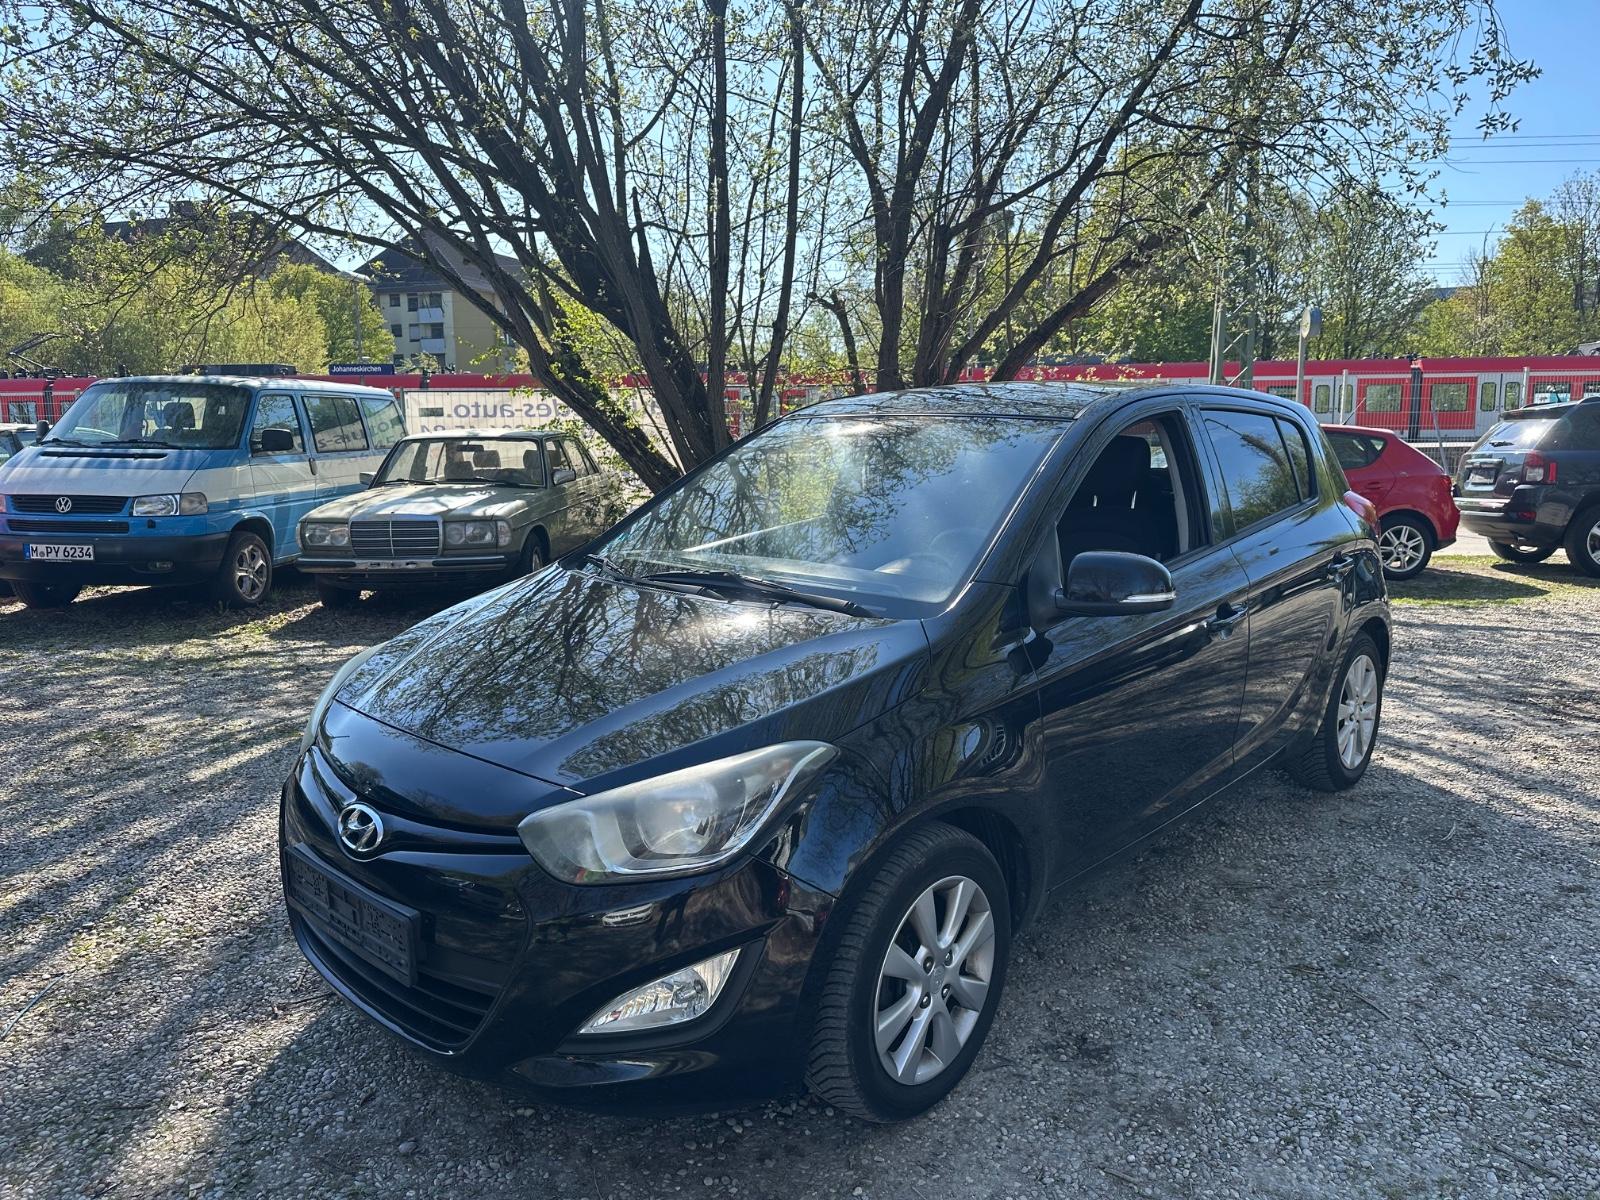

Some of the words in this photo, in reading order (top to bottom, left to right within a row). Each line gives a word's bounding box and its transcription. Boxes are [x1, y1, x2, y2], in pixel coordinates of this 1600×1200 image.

[332, 365, 382, 373] Johanneskirchen
[30, 545, 39, 558] M
[45, 546, 60, 558] PY
[63, 546, 92, 559] 6234
